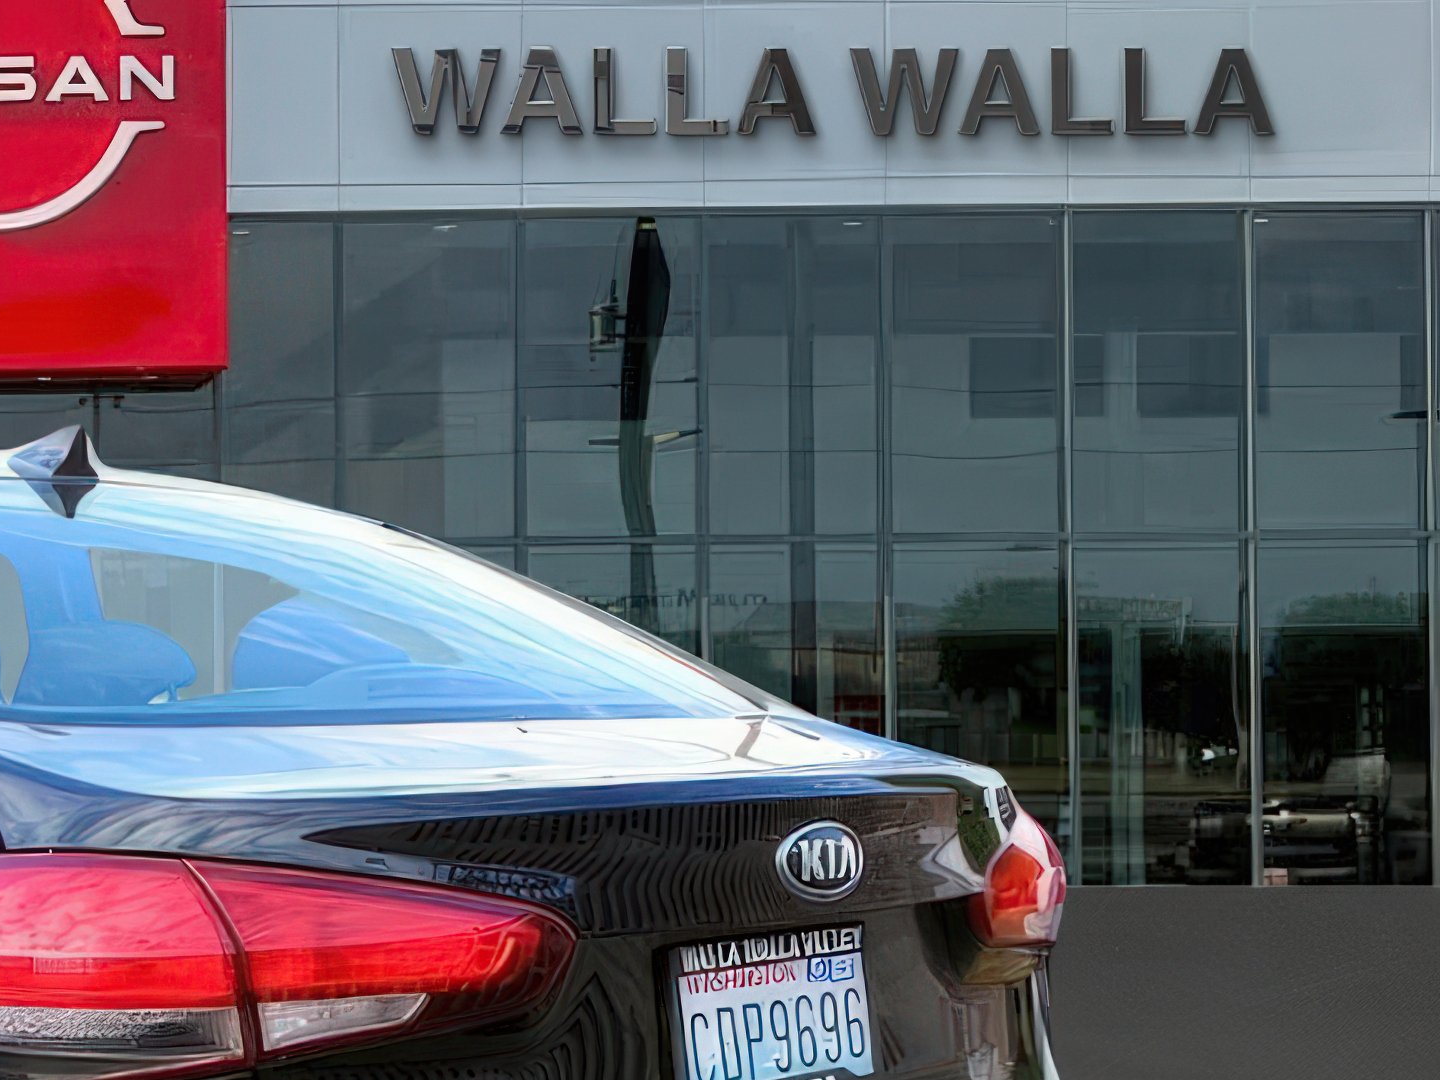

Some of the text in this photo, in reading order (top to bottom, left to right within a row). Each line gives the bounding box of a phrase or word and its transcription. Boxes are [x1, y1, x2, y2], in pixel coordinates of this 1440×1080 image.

[390, 46, 1276, 136] WALLA WALLA
[797, 834, 857, 882] KIA
